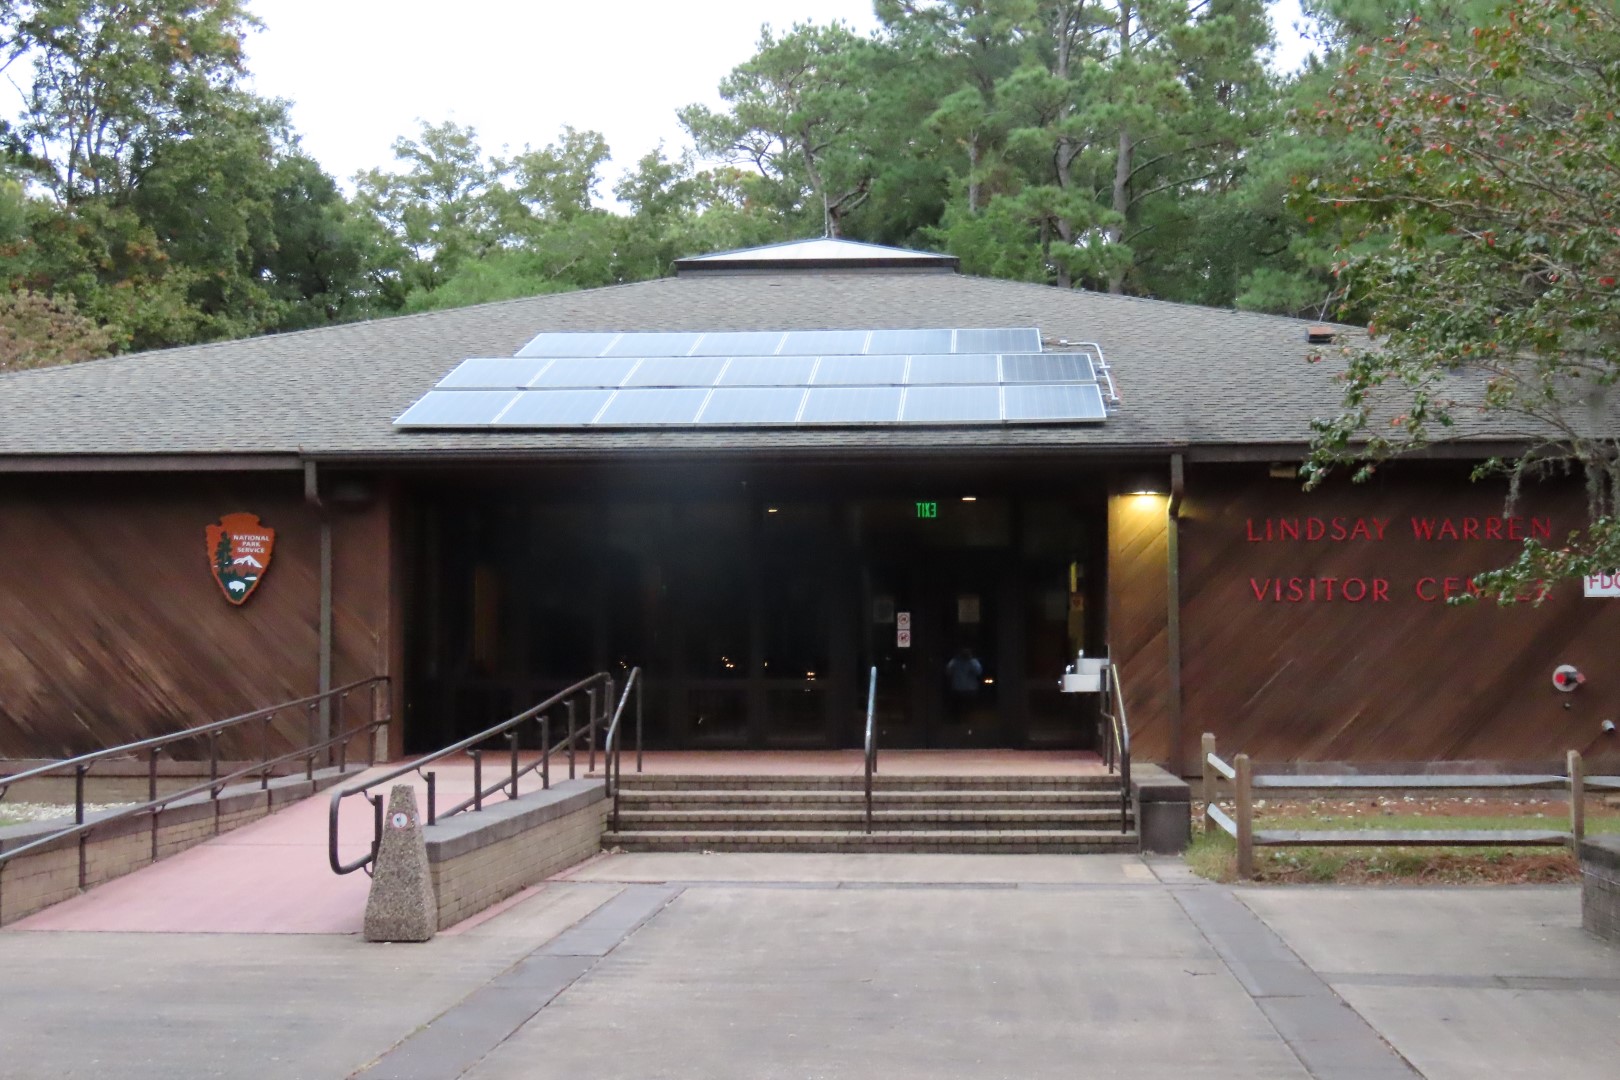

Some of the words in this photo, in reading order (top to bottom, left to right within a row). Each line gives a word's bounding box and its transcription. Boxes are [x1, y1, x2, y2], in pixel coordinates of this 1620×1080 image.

[233, 534, 270, 542] NATIONAL
[1246, 516, 1390, 541] LINDSAY
[1410, 516, 1551, 541] WARREN
[1250, 577, 1390, 602] VISITOR
